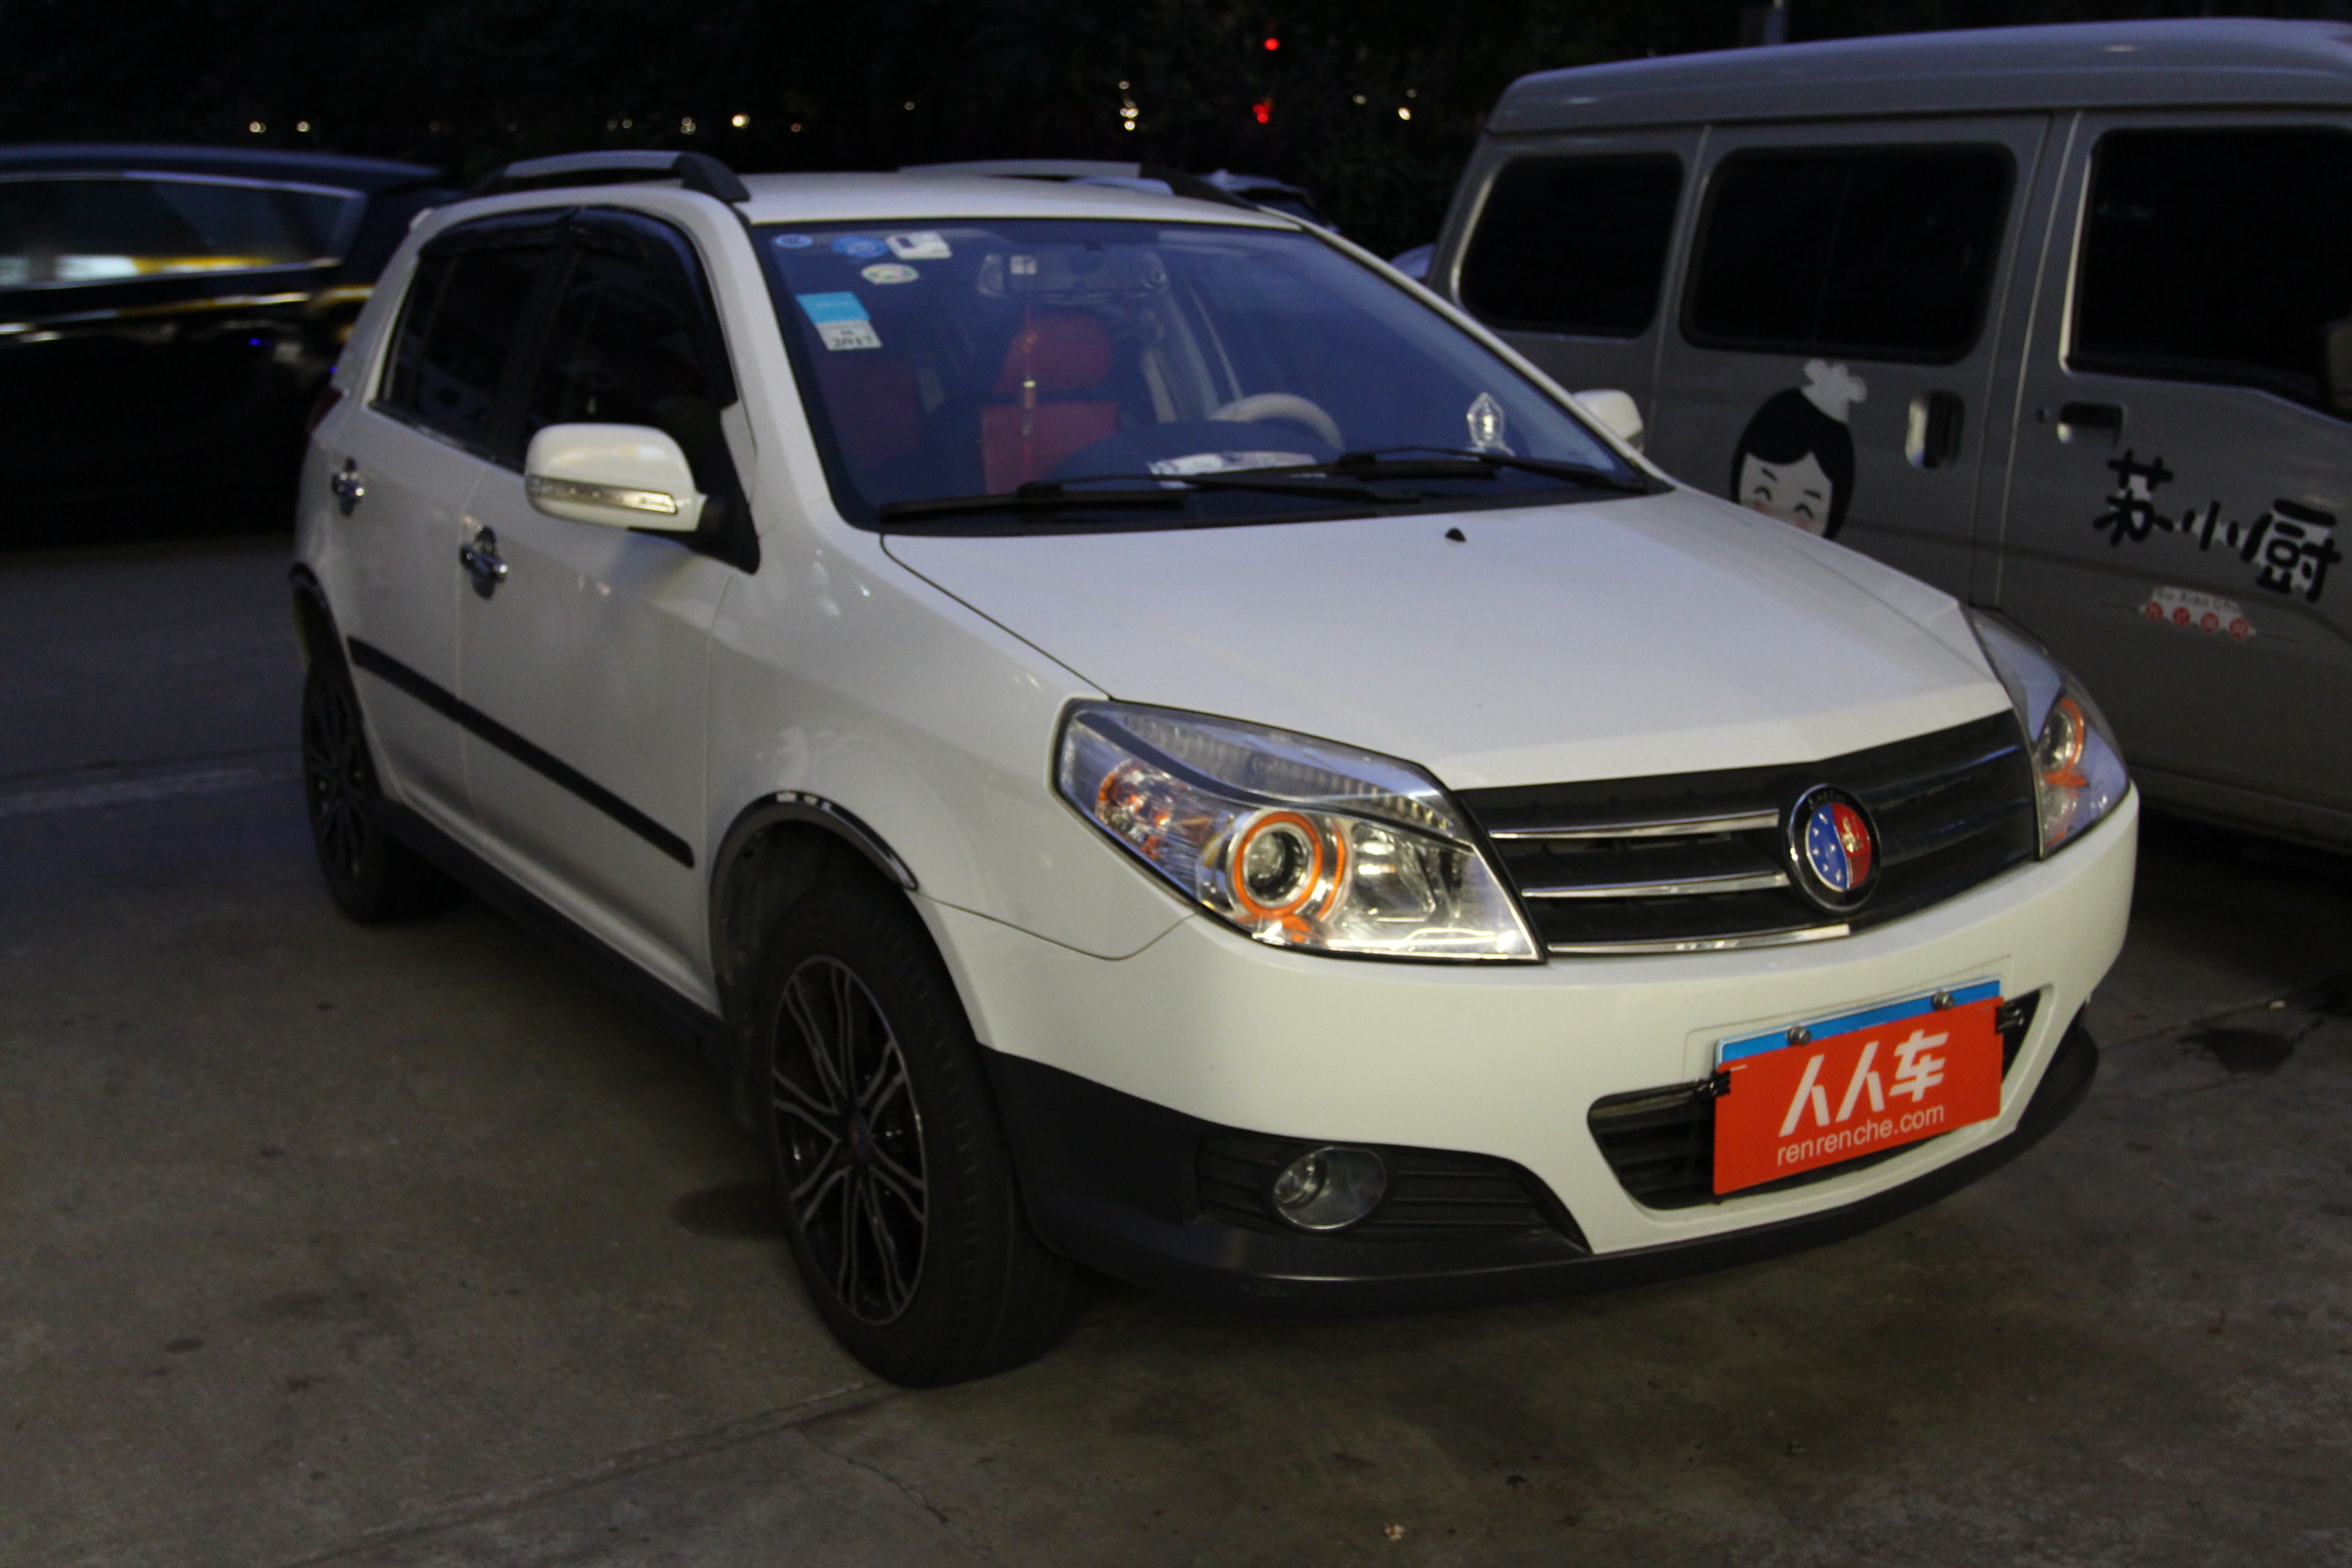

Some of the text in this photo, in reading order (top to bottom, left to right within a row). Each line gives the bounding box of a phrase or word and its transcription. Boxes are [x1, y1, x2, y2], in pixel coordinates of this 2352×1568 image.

[2092, 449, 2341, 603] 苏小厨
[1778, 1104, 1945, 1166] renrenche.com
[1779, 1029, 1949, 1138] 人人车
